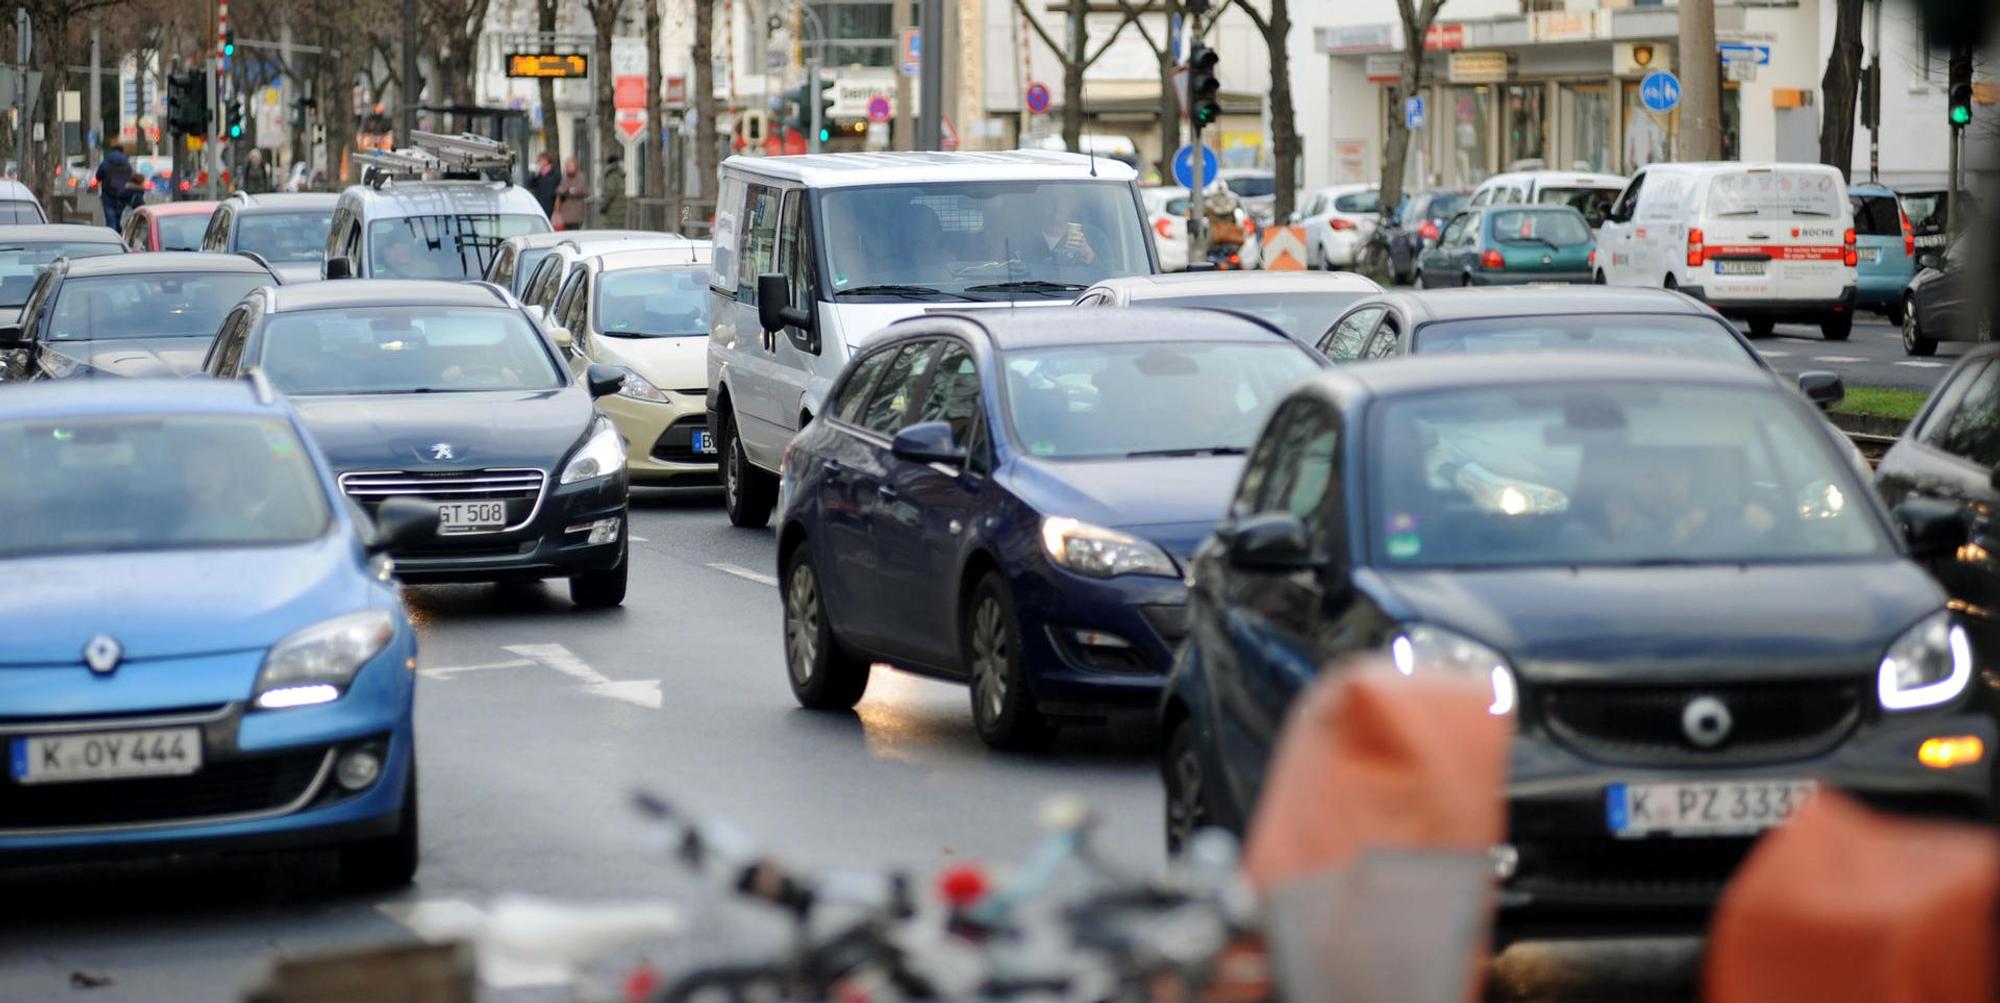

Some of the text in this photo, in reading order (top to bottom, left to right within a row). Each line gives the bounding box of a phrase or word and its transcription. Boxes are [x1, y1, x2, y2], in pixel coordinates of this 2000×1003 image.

[1802, 228, 1834, 237] ROCHE
[439, 504, 502, 523] GT 508
[41, 740, 62, 770] K
[130, 734, 187, 764] 444
[1631, 790, 1650, 819] K
[1677, 787, 1720, 821] PZ
